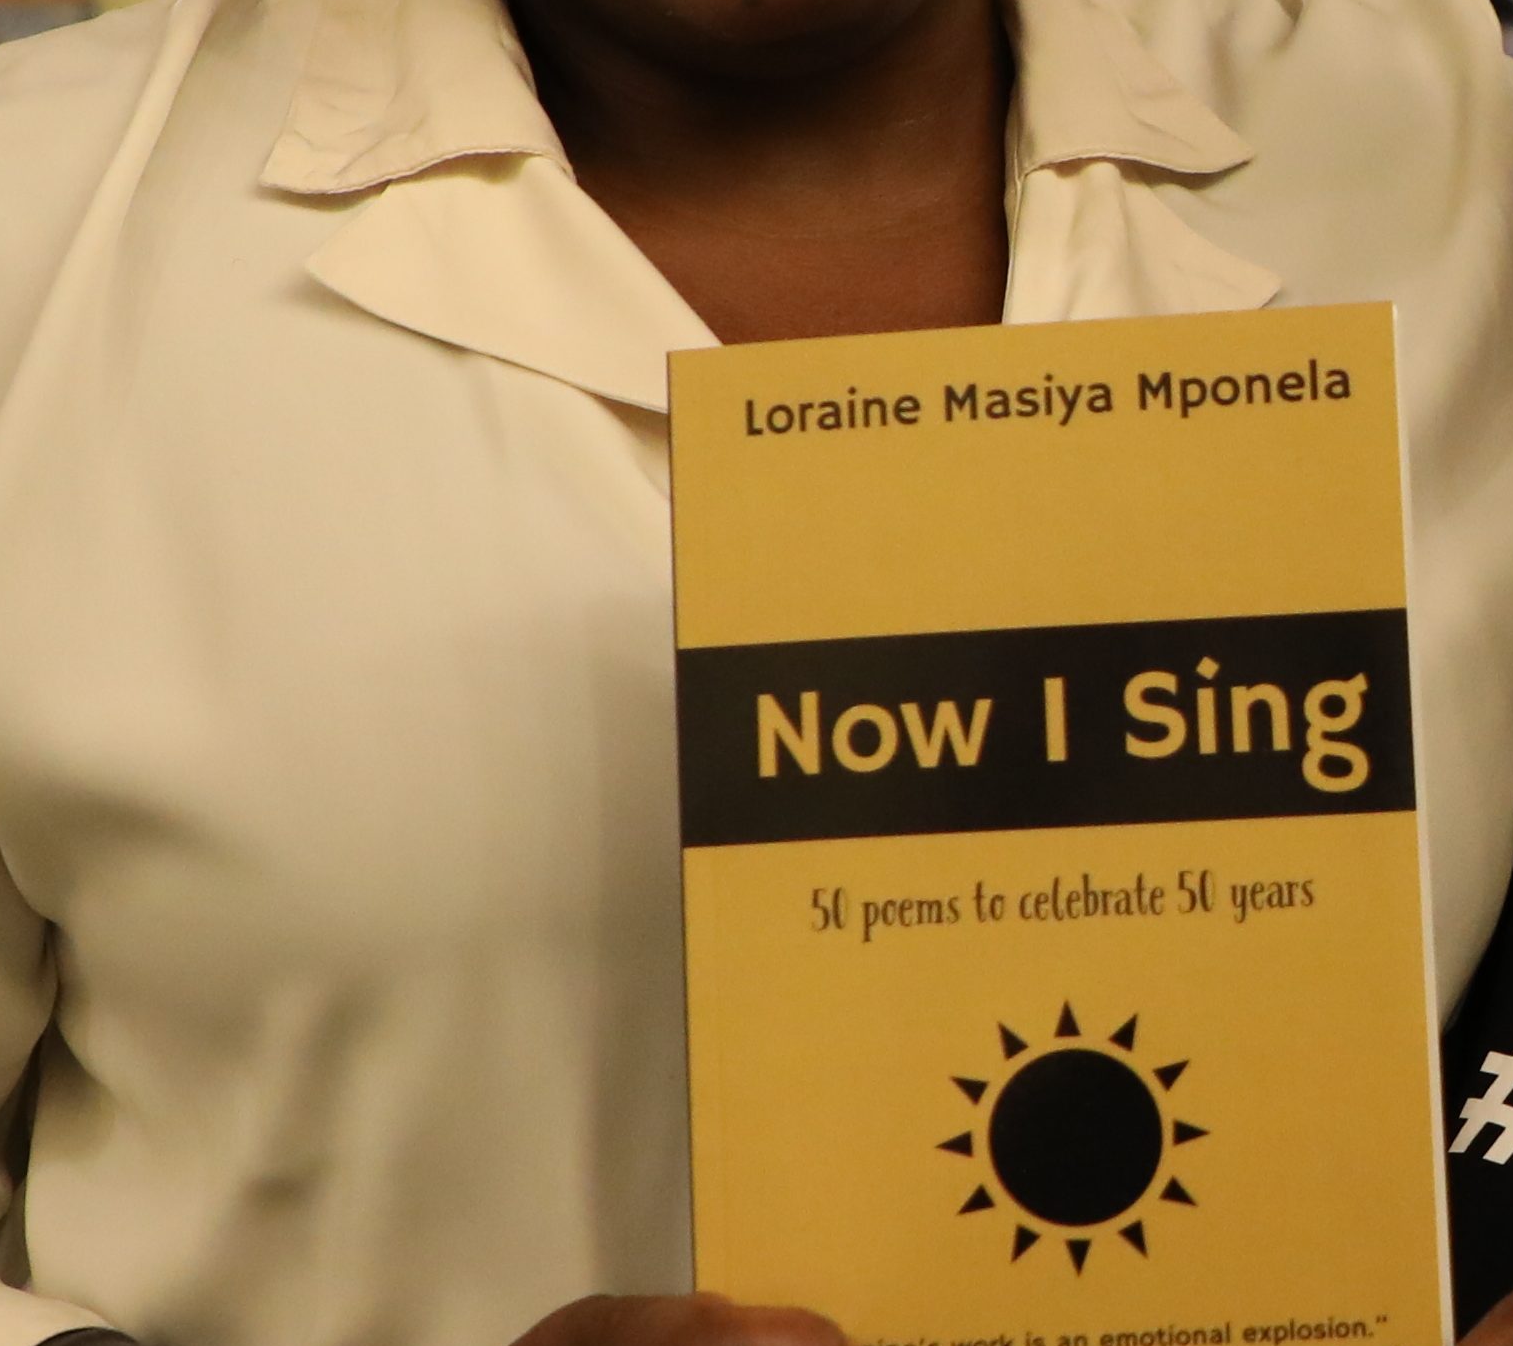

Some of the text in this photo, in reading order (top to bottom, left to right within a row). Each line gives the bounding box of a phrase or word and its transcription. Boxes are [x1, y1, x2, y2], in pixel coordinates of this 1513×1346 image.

[745, 358, 1351, 437] Loraine Masiya Mponela
[757, 656, 1369, 793] Now I Sing
[811, 869, 1314, 943] 50 poems to celebrate 50 years
